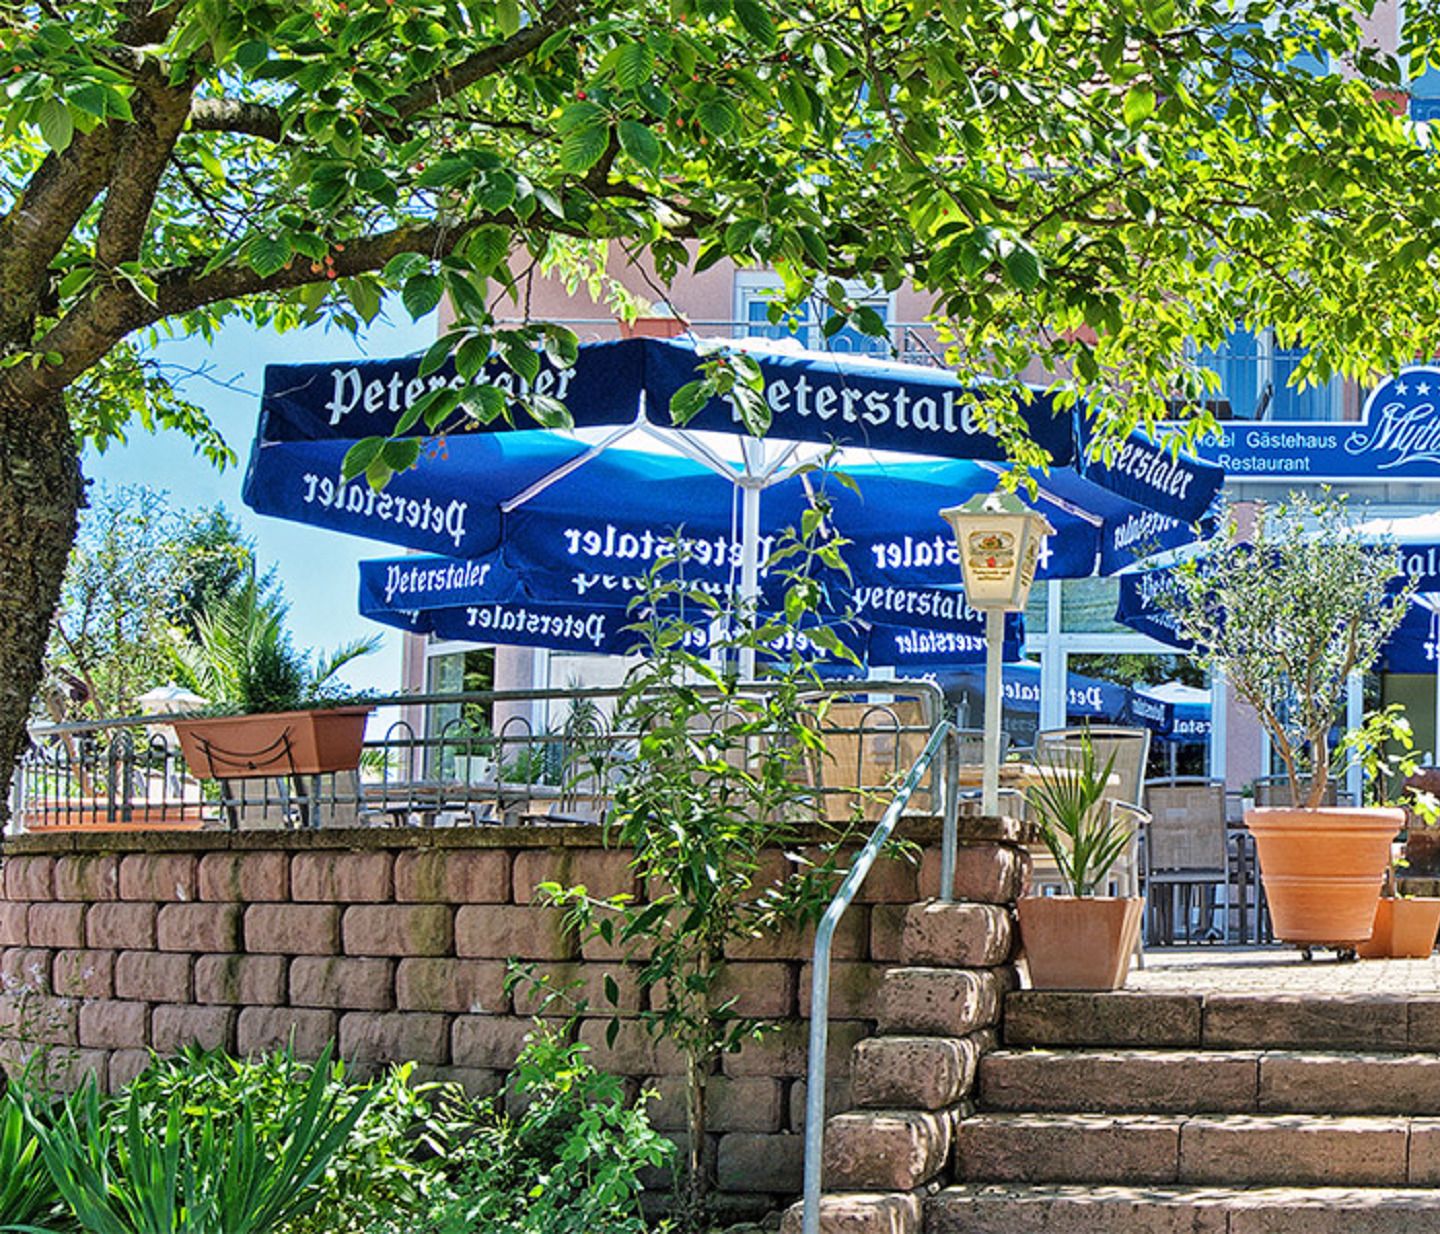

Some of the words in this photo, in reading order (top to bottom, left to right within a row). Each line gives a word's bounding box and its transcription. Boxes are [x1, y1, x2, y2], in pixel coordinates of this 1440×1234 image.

[722, 374, 997, 437] eterstale
[1194, 431, 1236, 448] Hoel
[1246, 430, 1338, 448] Gästehaus
[1218, 454, 1311, 471] Restaurant
[385, 560, 491, 603] Peterstaler
